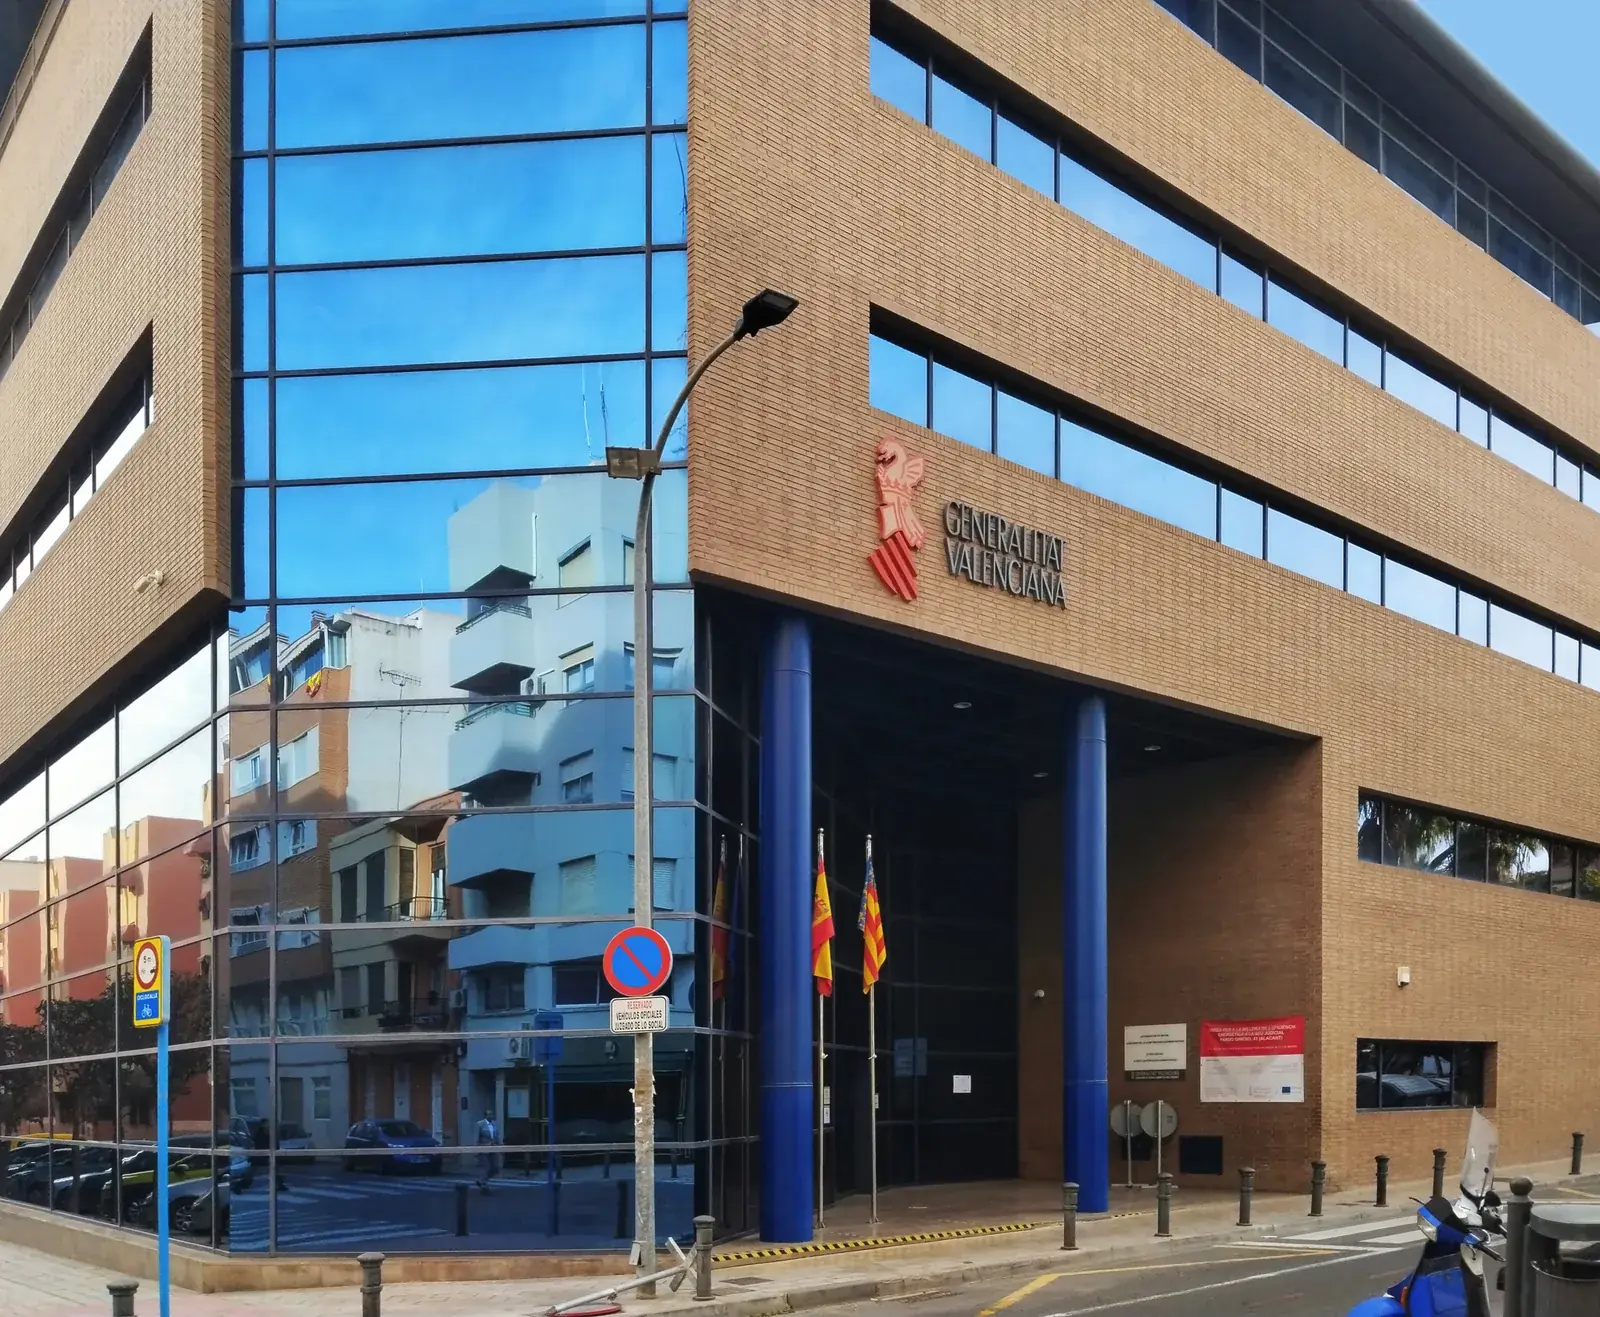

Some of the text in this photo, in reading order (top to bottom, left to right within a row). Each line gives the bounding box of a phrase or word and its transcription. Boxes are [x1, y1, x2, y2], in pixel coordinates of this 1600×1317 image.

[943, 500, 1066, 573] GENERALITAT
[944, 536, 1067, 610] VALENCIANA
[627, 1000, 652, 1009] RESERVADO
[640, 1010, 663, 1019] OFICIALES
[614, 1020, 664, 1030] JUZGADO DE LO SOCIAL
